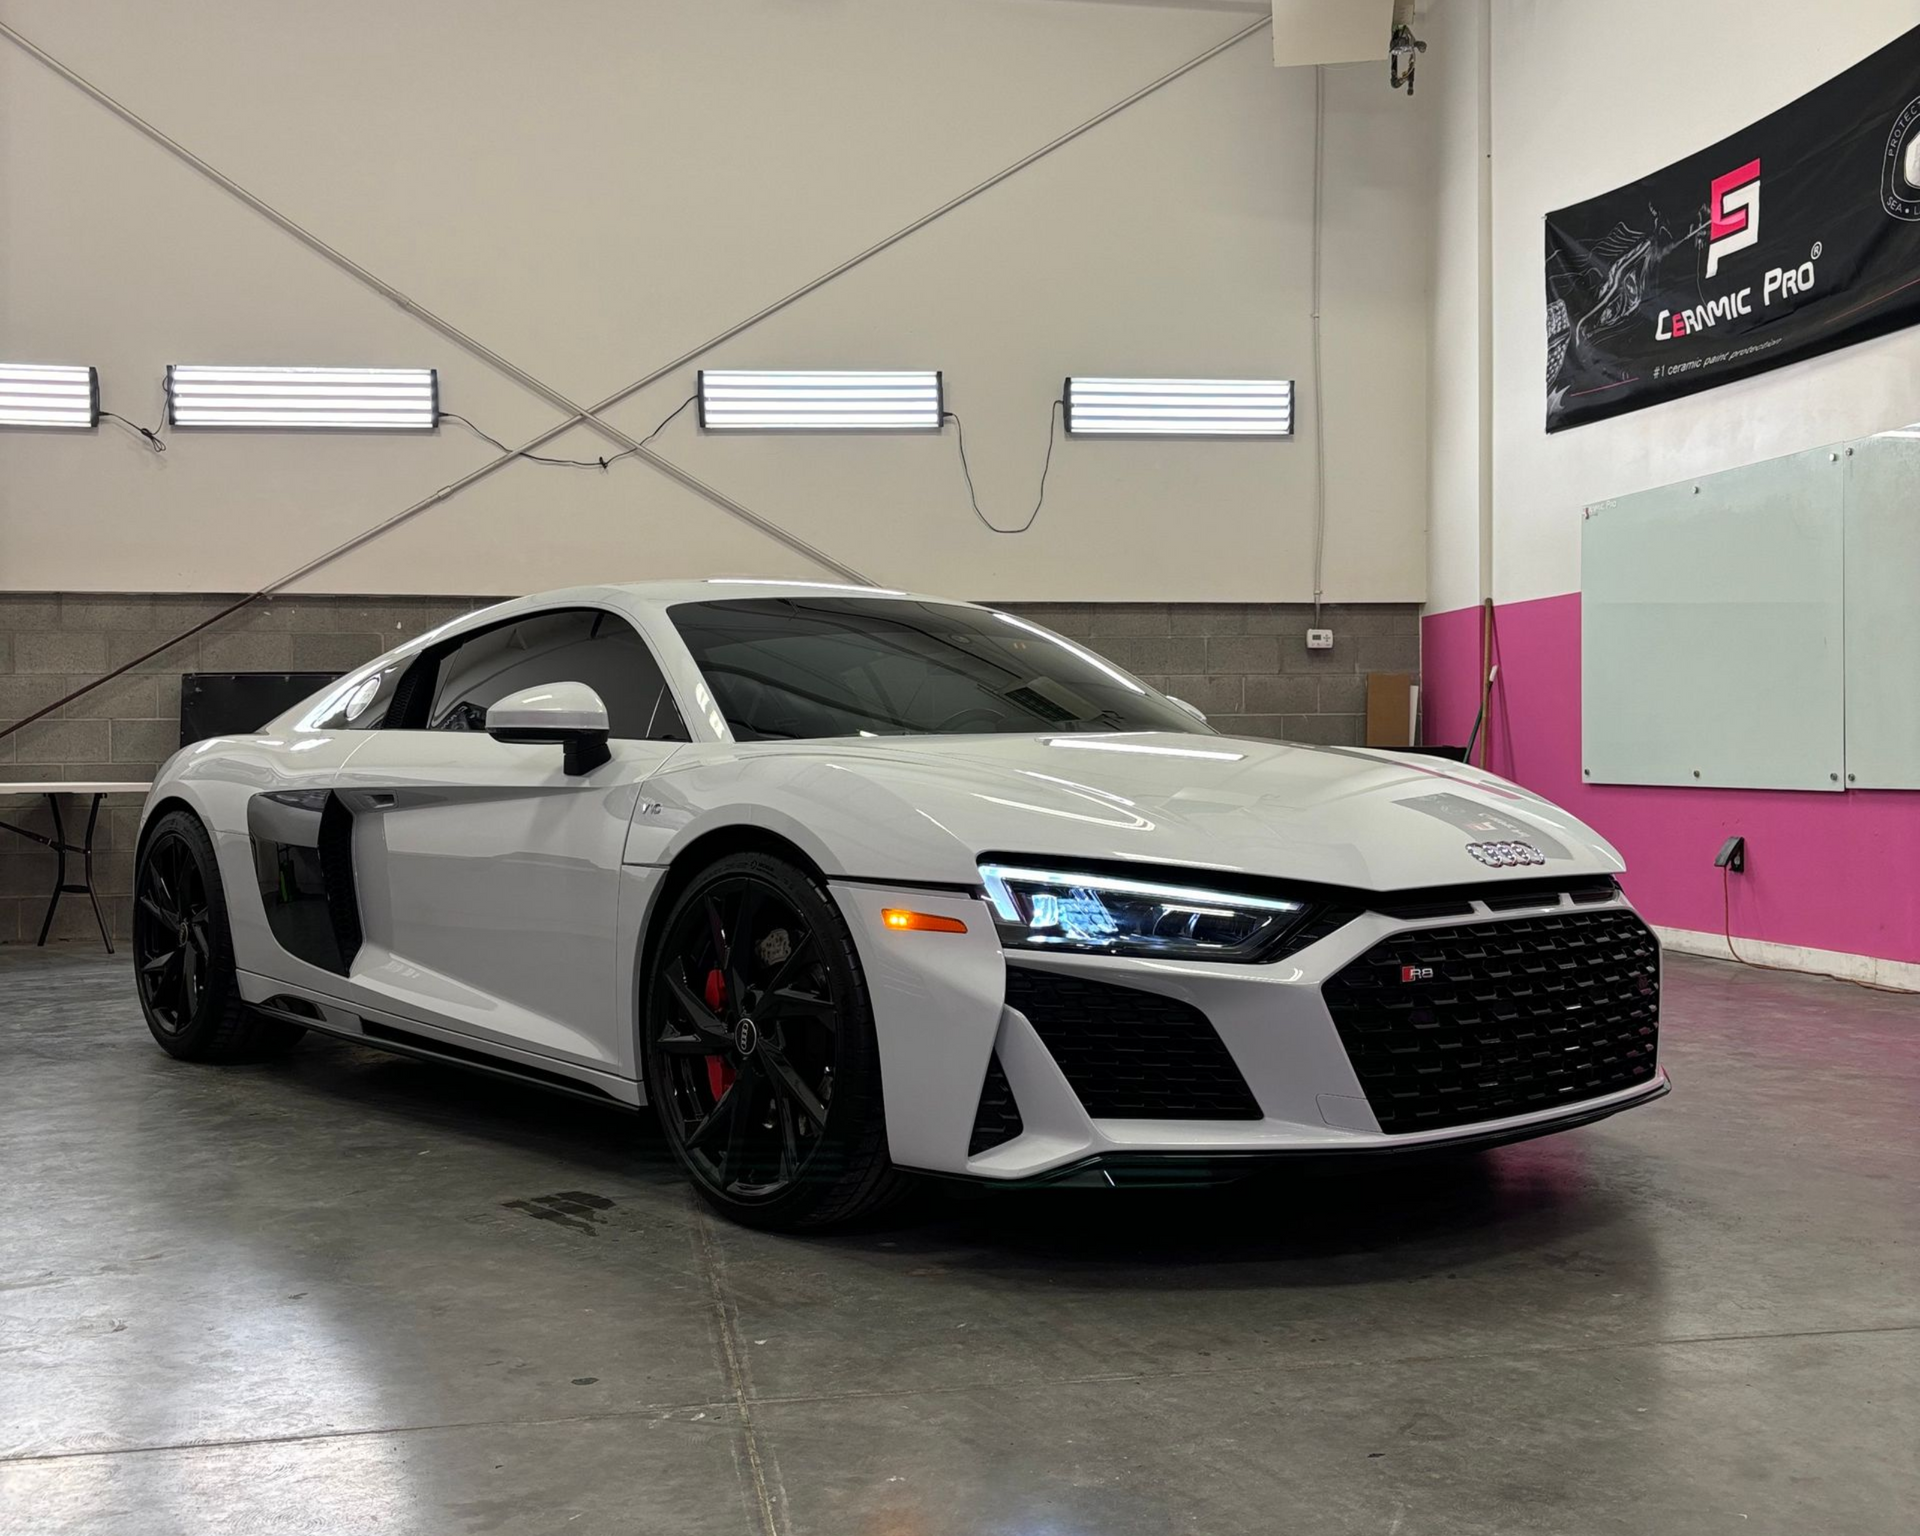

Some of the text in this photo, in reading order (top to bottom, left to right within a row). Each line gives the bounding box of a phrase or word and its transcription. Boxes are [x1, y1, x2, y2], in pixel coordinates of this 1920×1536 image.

[1888, 101, 1920, 157] PROTEC
[1886, 196, 1903, 213] SEA
[1655, 287, 1752, 341] CERAMIC
[1653, 364, 1665, 379] #1
[1667, 357, 1702, 376] ceramic
[1703, 351, 1730, 368] paint
[1410, 967, 1433, 979] R8
